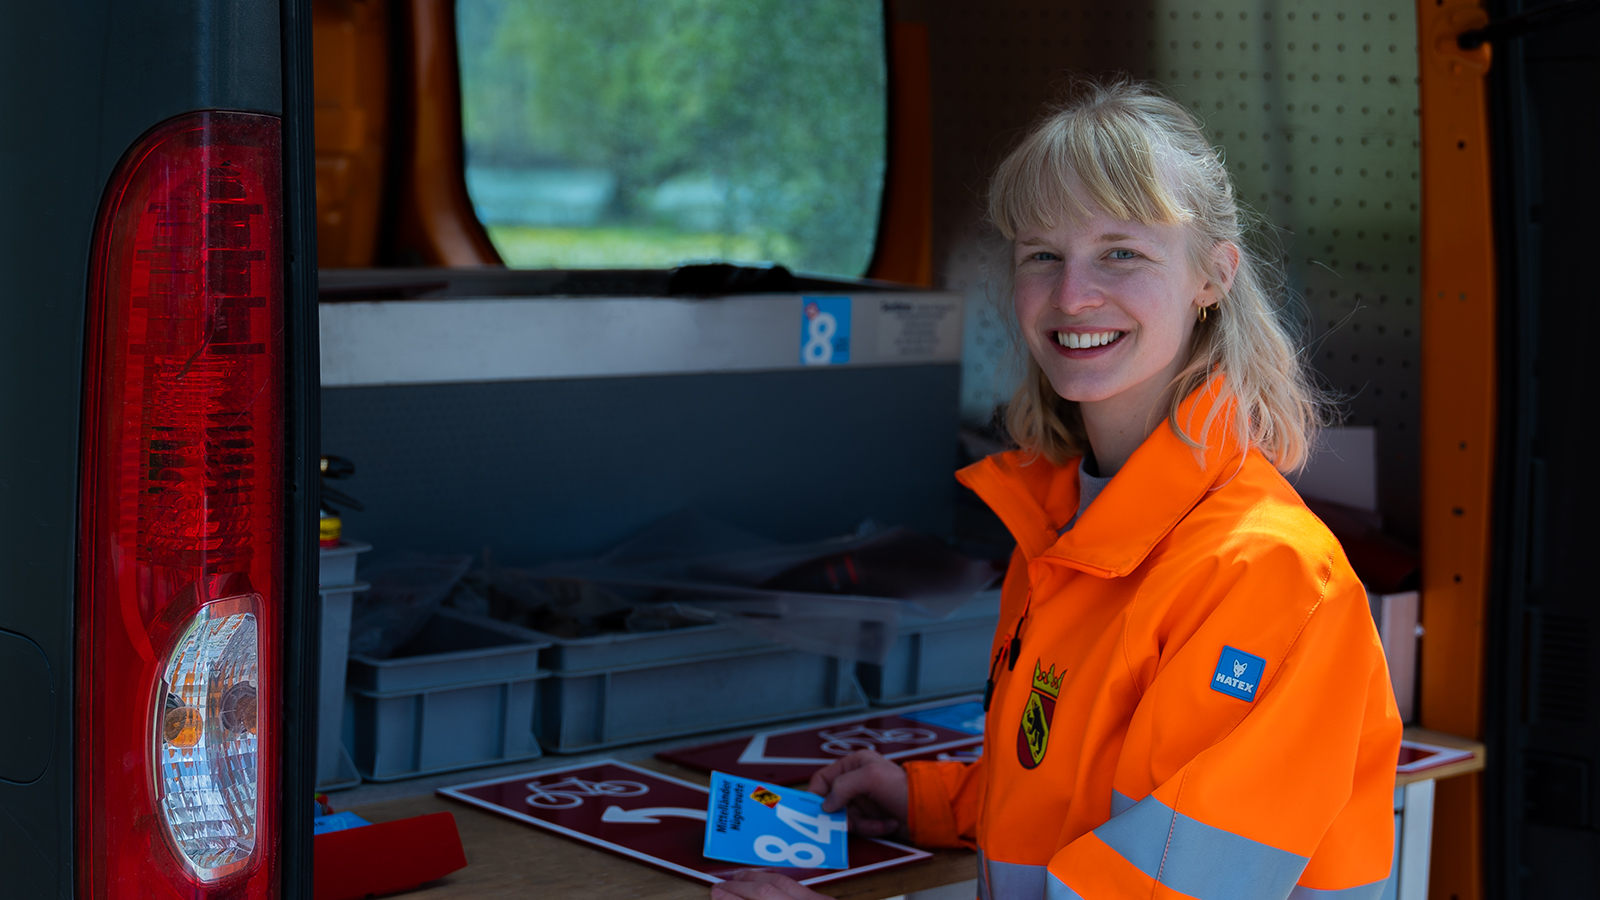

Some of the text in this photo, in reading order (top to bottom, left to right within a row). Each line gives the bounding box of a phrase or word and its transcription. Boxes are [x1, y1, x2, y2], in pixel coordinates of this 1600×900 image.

[803, 312, 837, 365] 8
[1215, 673, 1254, 693] HATEX
[715, 780, 732, 833] Mittelländer
[730, 783, 745, 831] Hügelroute
[753, 804, 847, 868] 84
